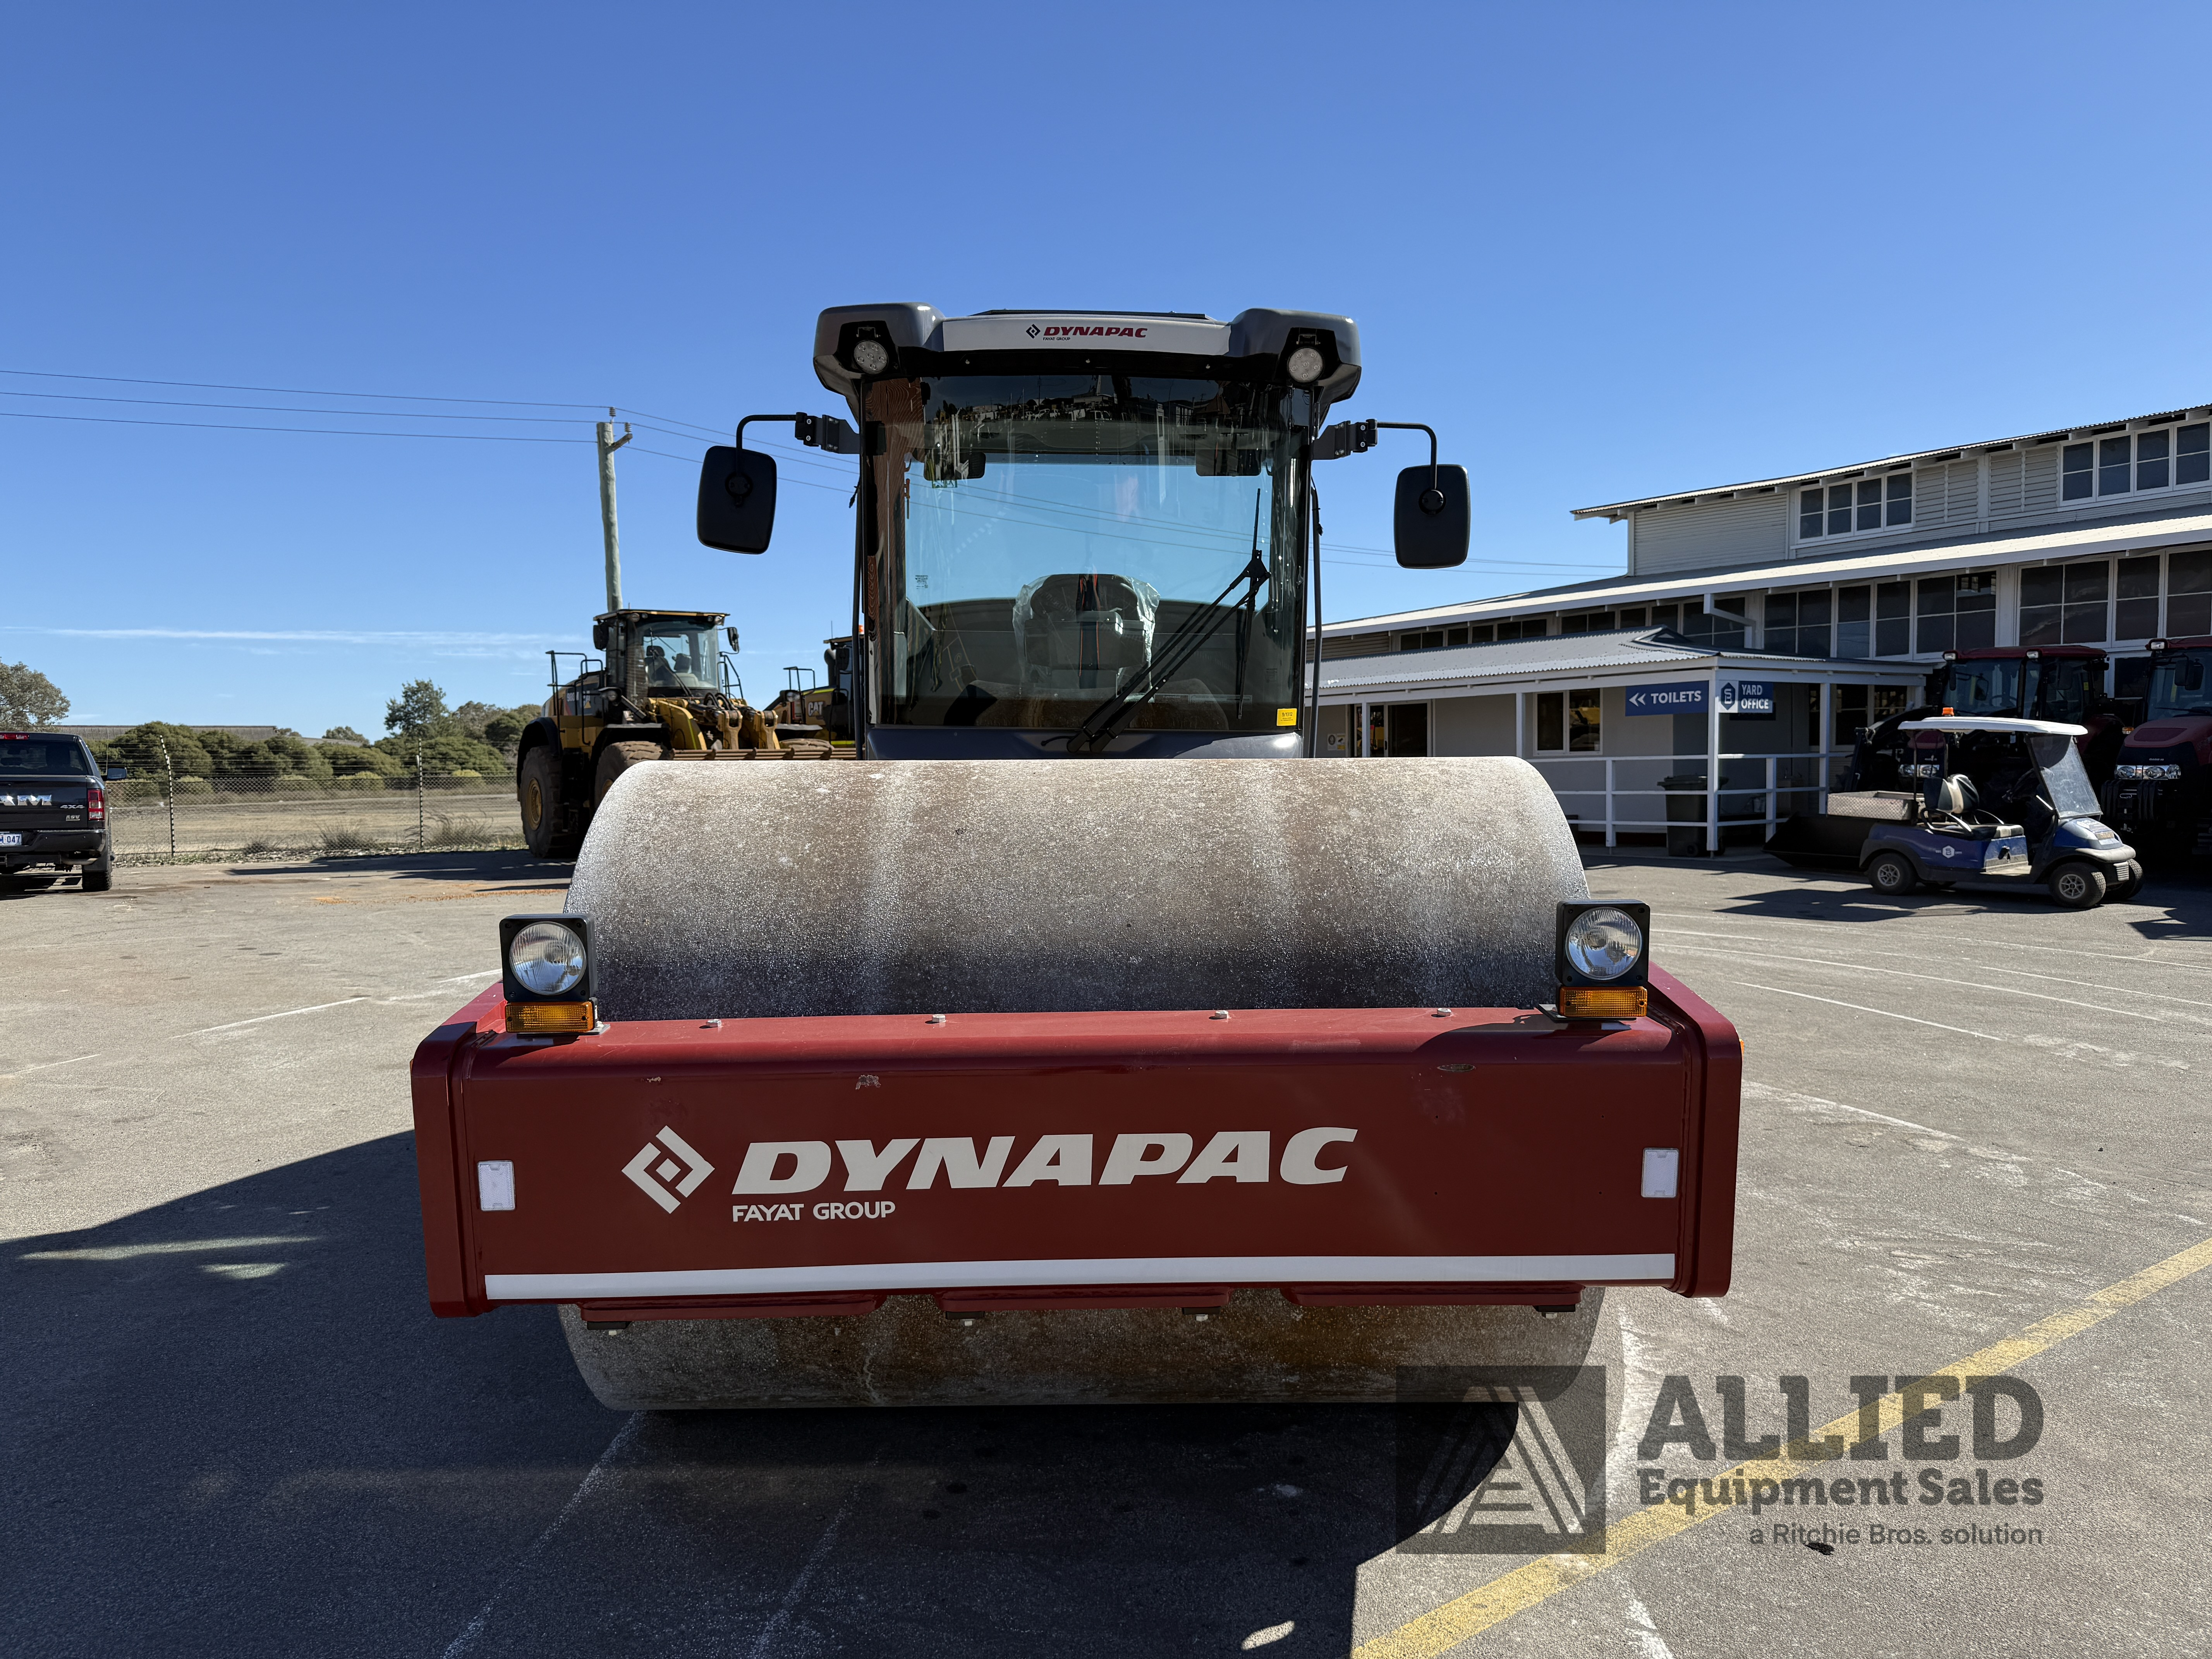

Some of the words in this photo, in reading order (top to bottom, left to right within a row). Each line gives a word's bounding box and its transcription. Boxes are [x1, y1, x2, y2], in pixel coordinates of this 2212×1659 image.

[1043, 326, 1148, 338] DYNAPAC
[1650, 690, 1701, 704] TOILETS
[1741, 684, 1762, 696] YARD
[808, 701, 823, 716] CAT
[1741, 698, 1769, 709] OFFICE
[732, 1127, 1358, 1195] DYNAPAC
[732, 1202, 804, 1222] FAYAT
[813, 1201, 896, 1220] GROUP
